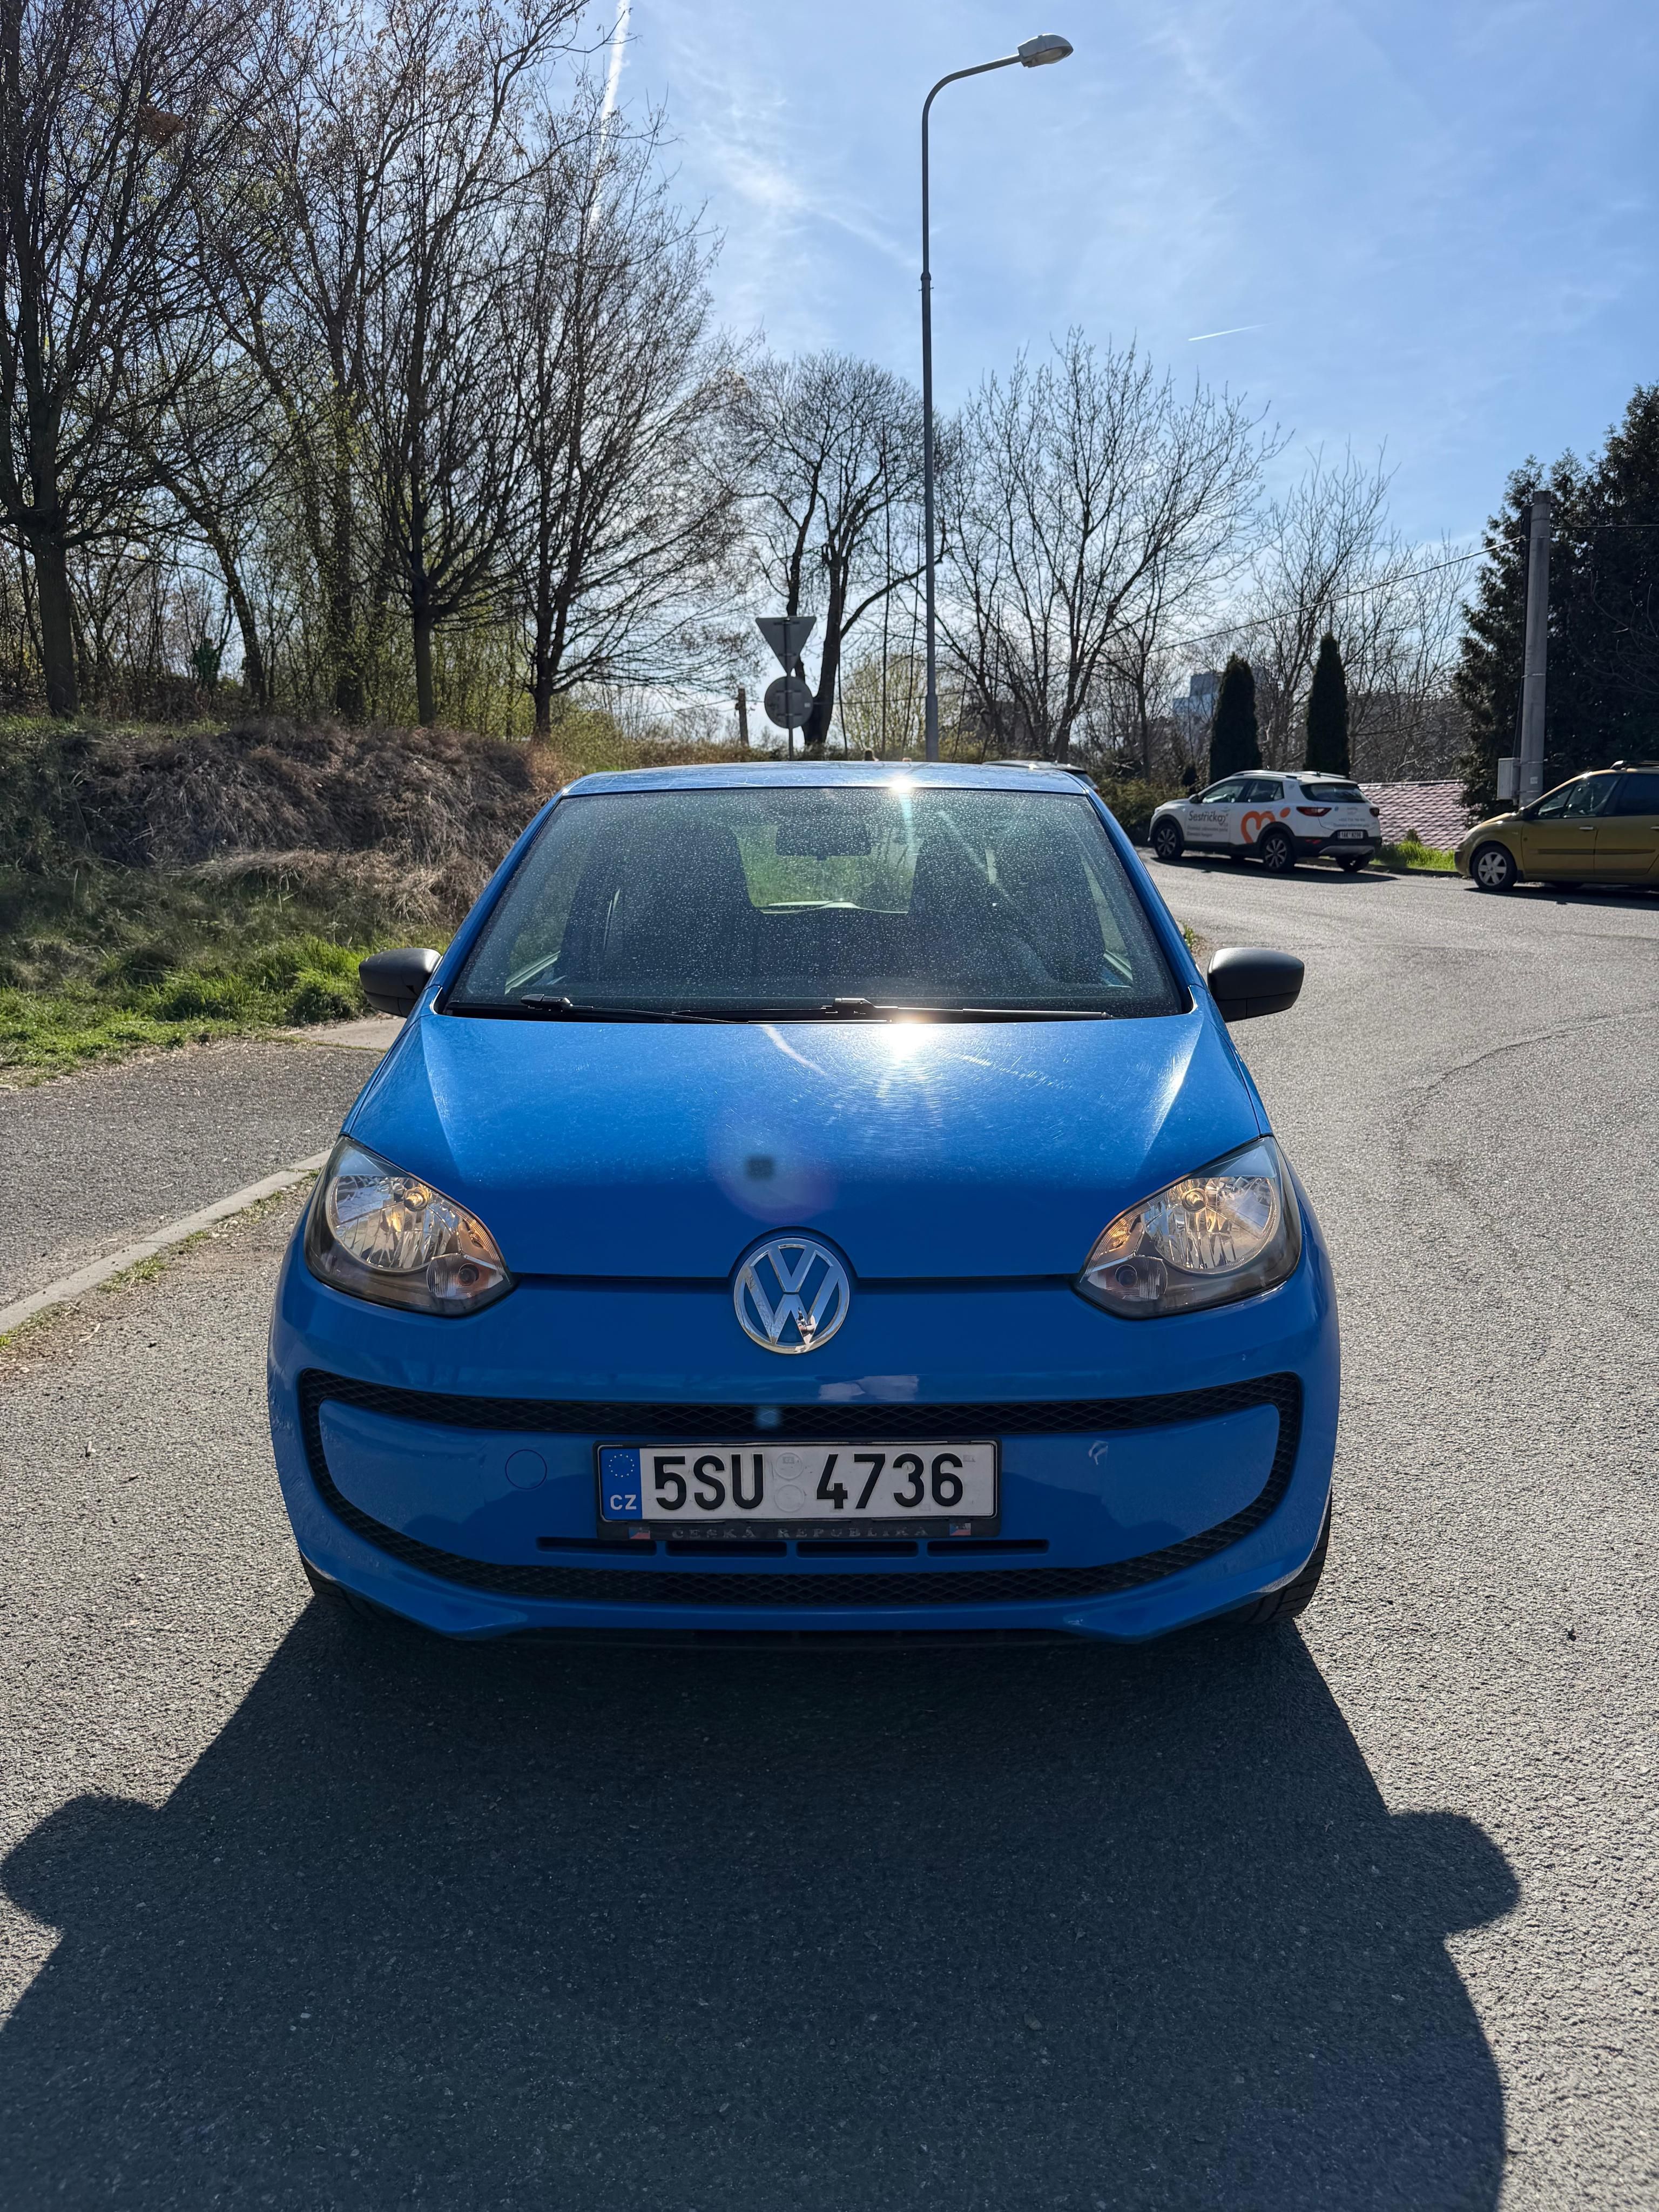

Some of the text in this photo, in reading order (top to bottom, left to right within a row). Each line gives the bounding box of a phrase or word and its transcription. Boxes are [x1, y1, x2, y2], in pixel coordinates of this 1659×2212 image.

[654, 1453, 963, 1510] 5SU 4736
[610, 1494, 637, 1510] CZ
[777, 1527, 928, 1537] REPUBLIKA
